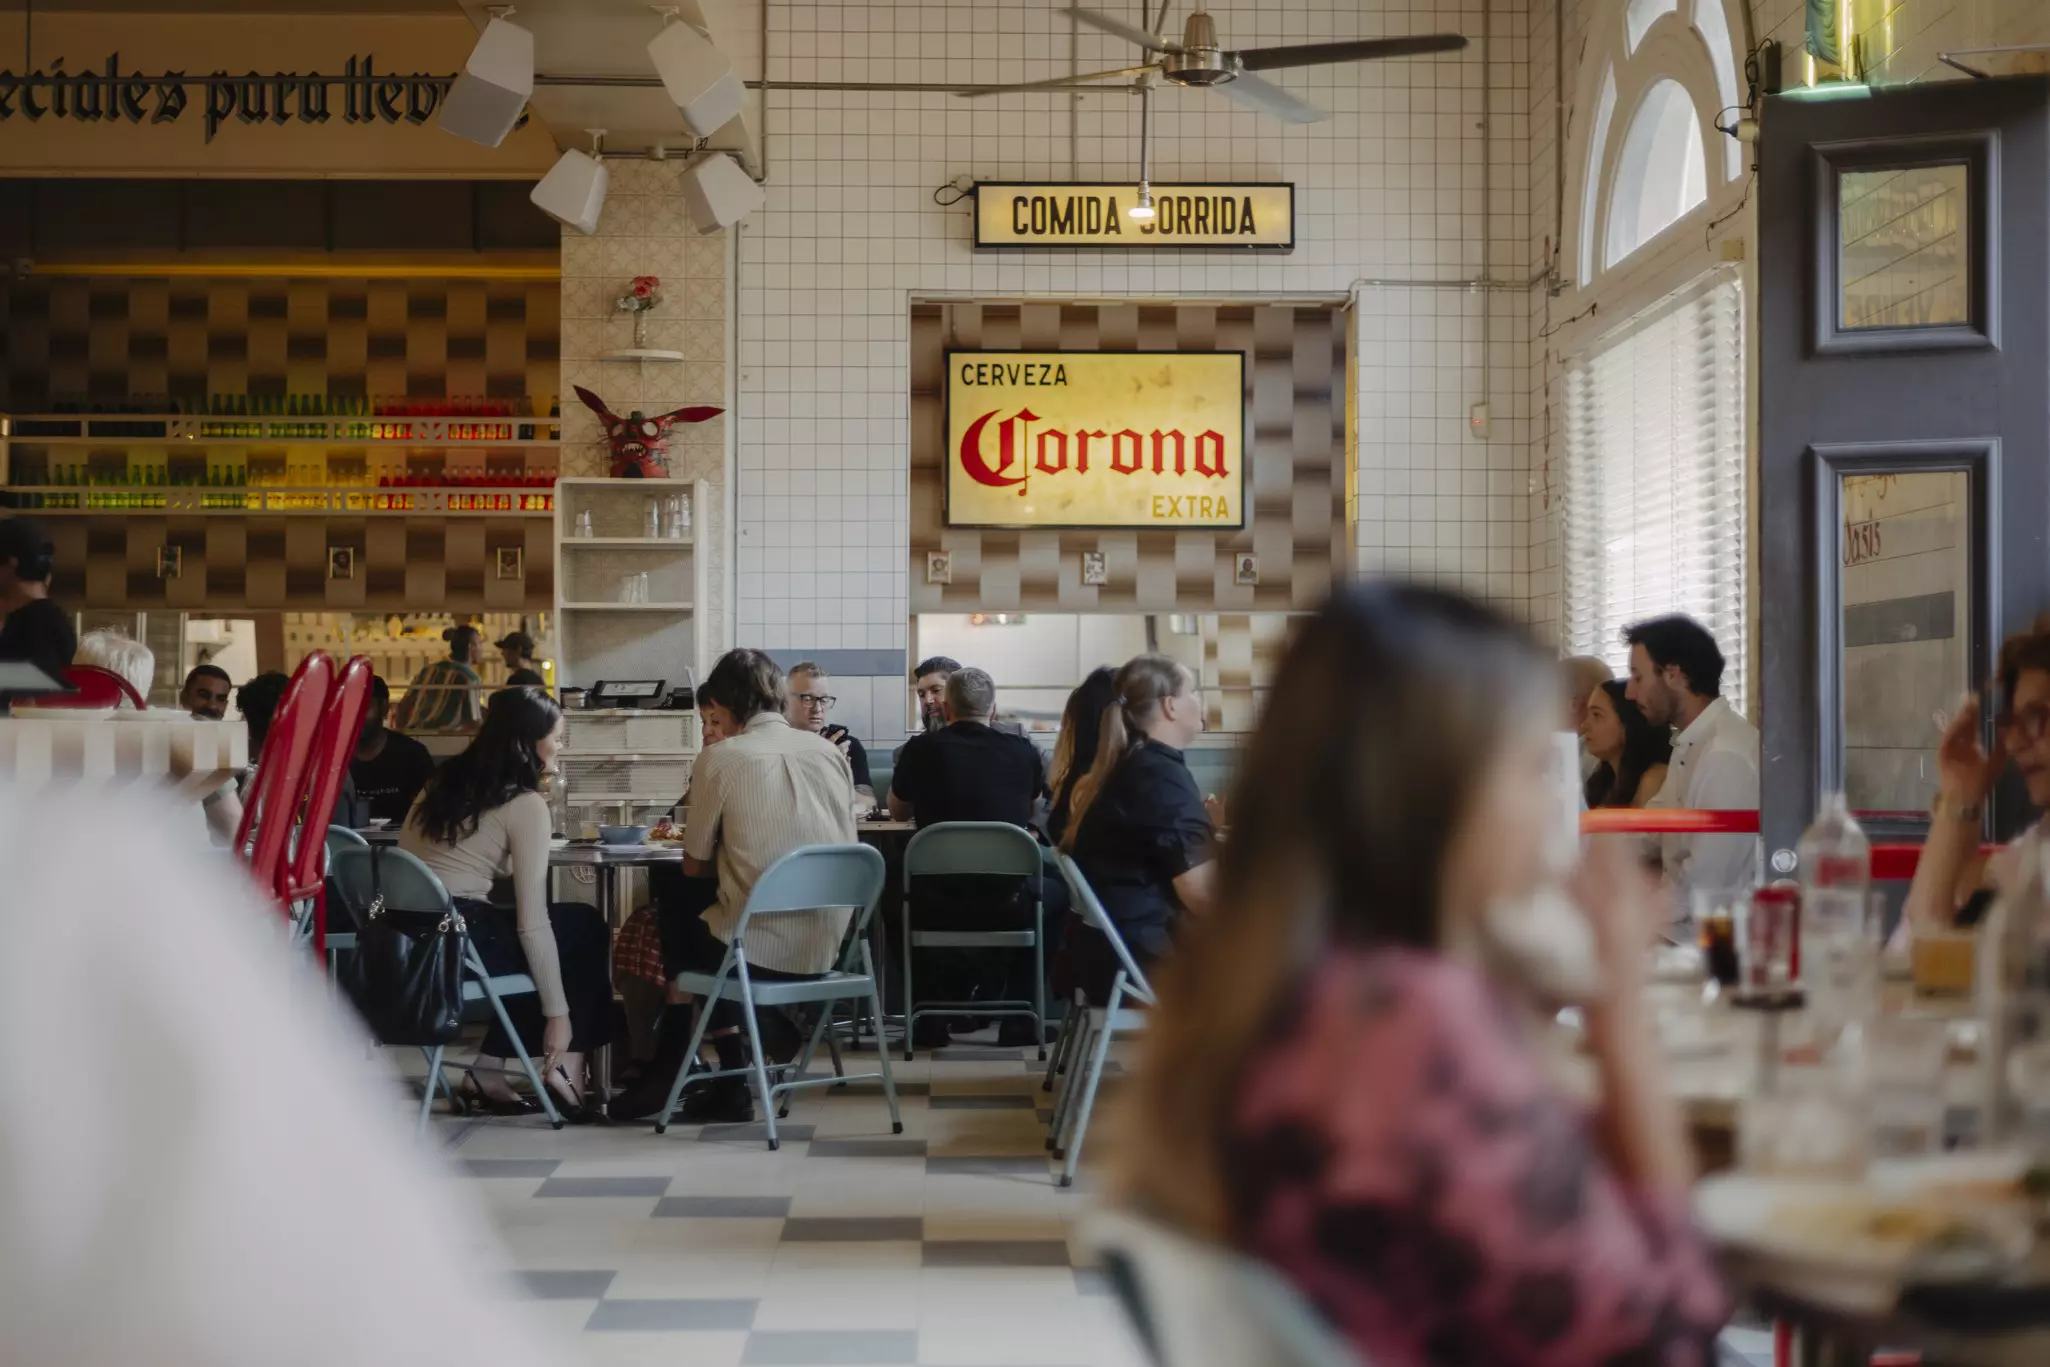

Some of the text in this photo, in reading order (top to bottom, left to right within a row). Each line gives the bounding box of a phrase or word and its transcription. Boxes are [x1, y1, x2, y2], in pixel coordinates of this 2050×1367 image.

[203, 70, 331, 145] para
[1012, 196, 1256, 235] COMIDA CORRIDA
[961, 363, 1068, 387] CERVEZA
[960, 407, 1230, 497] Corona
[1152, 496, 1229, 519] EXTRA
